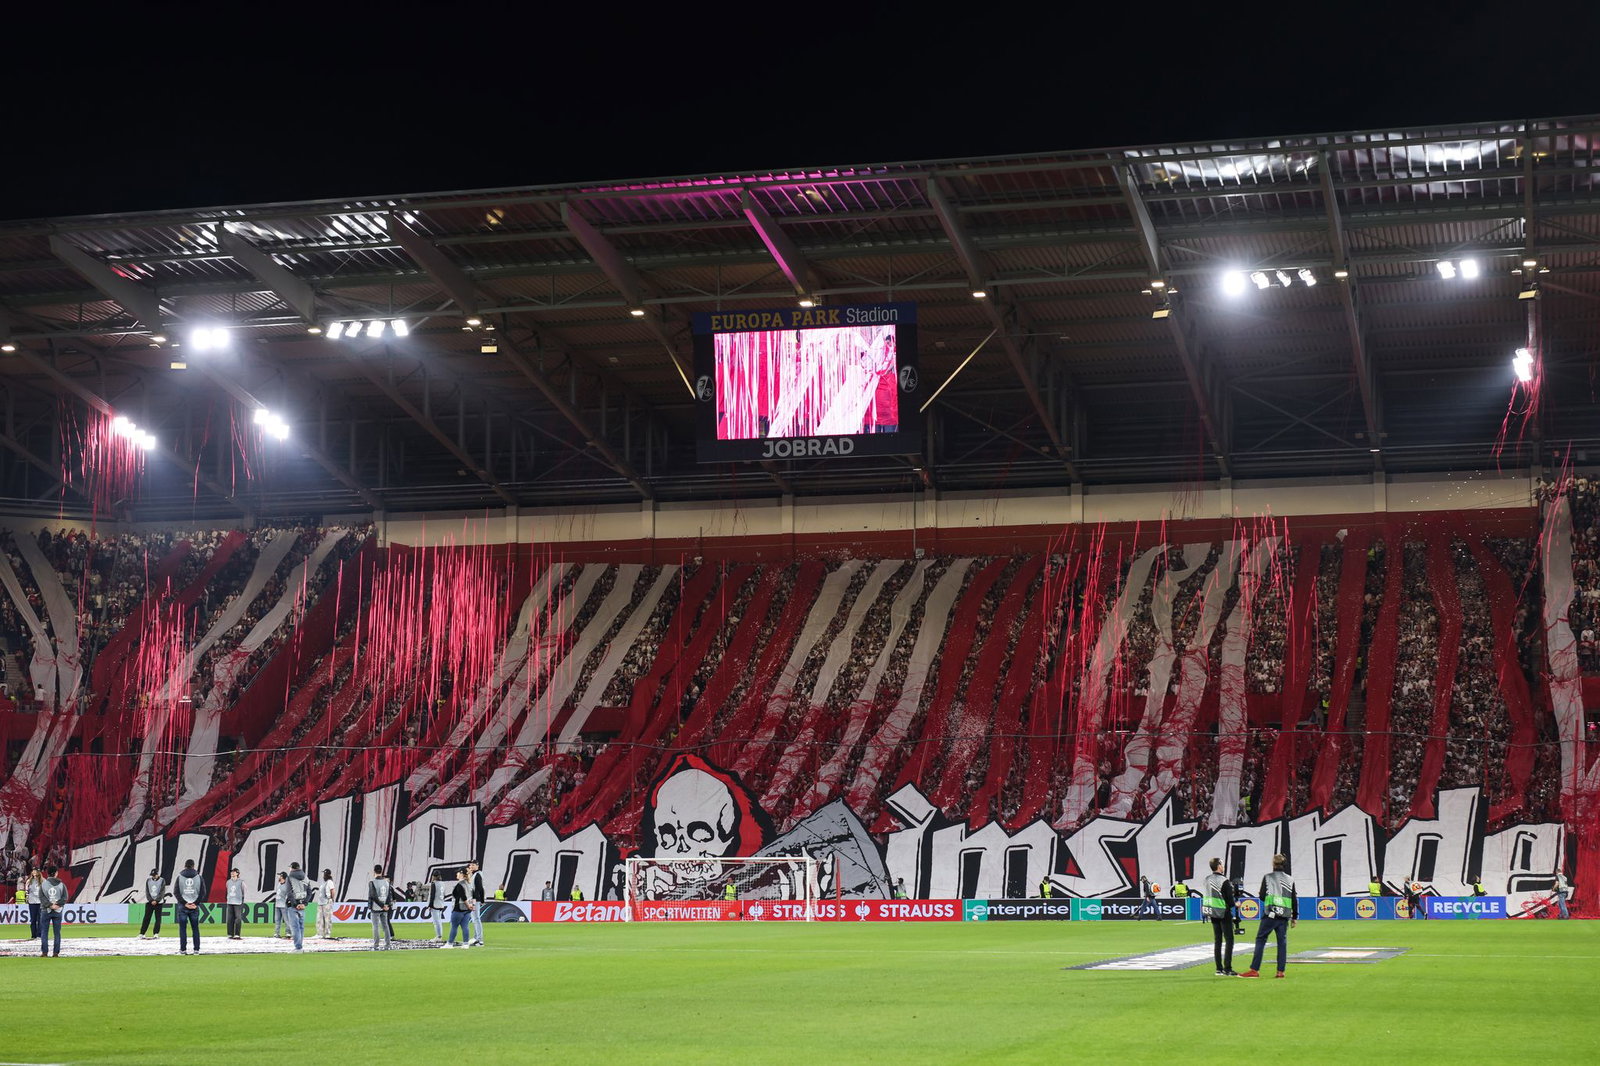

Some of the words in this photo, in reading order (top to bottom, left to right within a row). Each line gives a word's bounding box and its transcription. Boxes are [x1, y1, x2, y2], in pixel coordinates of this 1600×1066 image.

[711, 312, 784, 331] EUROPA
[792, 309, 841, 326] PARK
[846, 306, 899, 324] Stadion
[762, 438, 855, 458] JOBRAD
[0, 905, 97, 924] wisote
[353, 905, 448, 920] HKOO
[643, 906, 722, 920] SPORTWETTEN
[773, 904, 847, 918] STRAUSS
[879, 904, 954, 918] STRAUSS
[971, 902, 1075, 917] enterprise
[1433, 902, 1499, 913] RECYCLE
